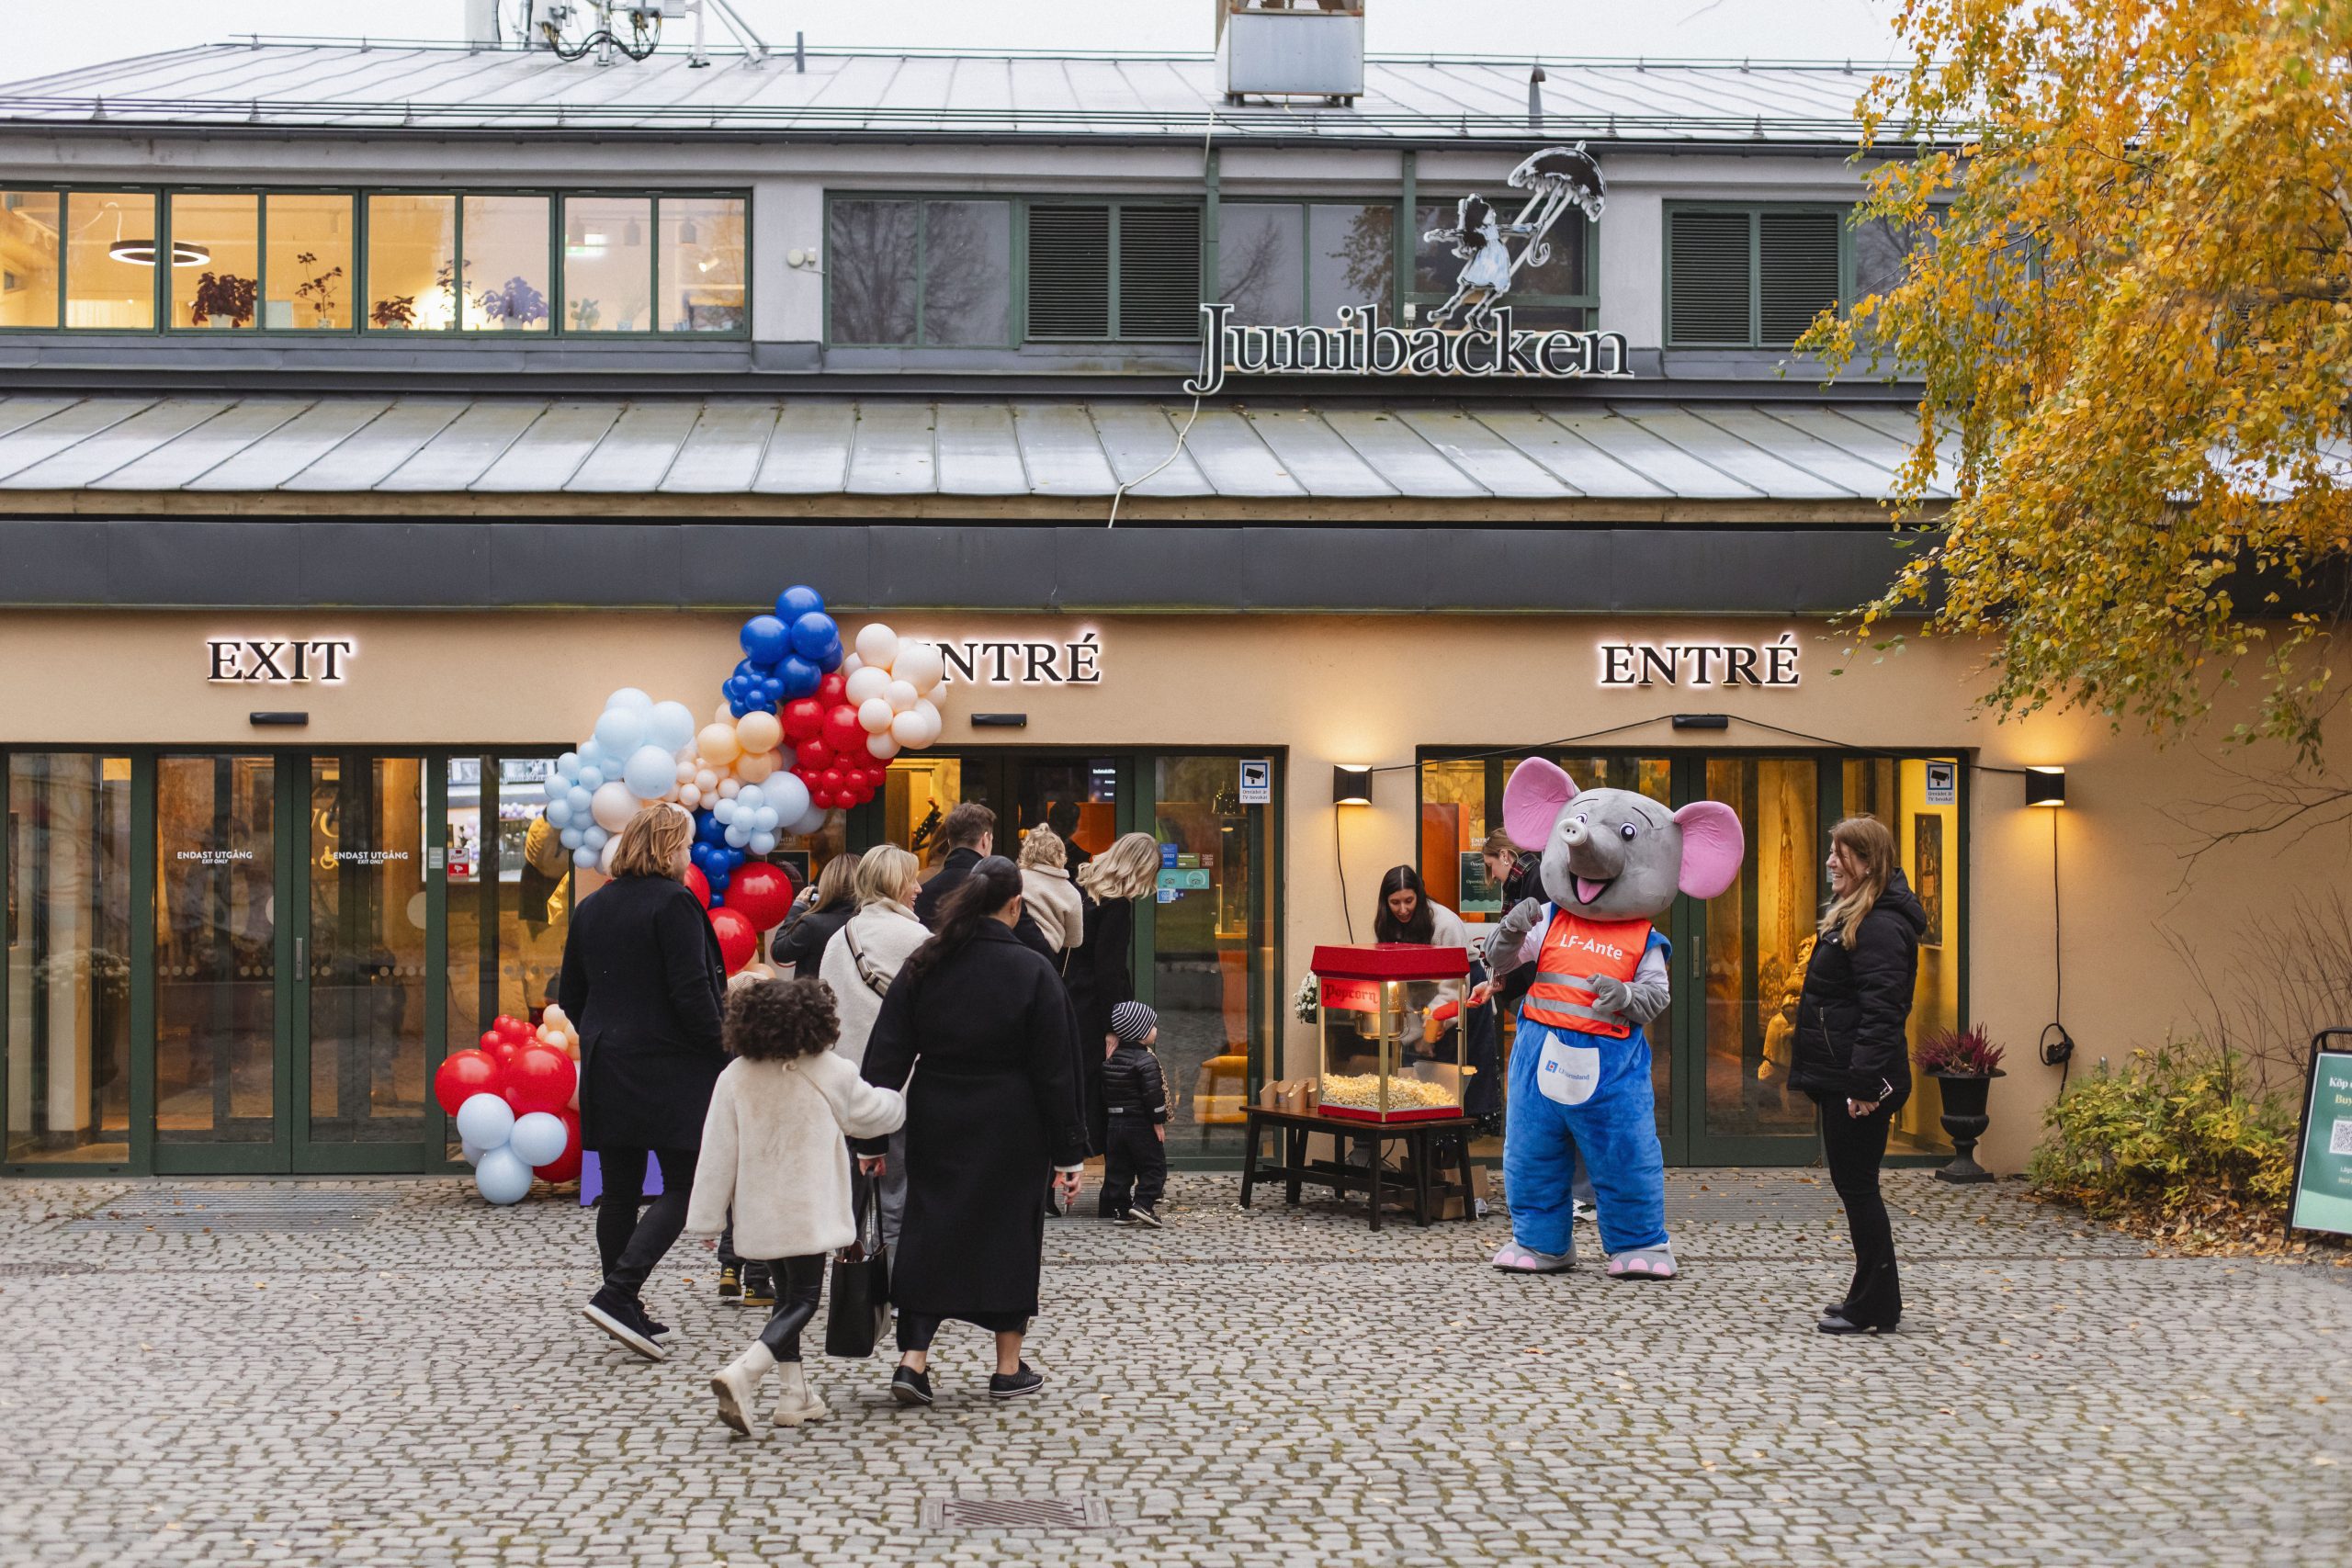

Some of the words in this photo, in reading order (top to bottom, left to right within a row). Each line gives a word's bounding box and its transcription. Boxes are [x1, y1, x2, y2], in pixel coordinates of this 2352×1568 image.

[1183, 303, 1634, 395] Junibacken
[207, 641, 350, 680] EXIT
[919, 633, 1100, 682] NTRÉ
[1600, 634, 1799, 684] ENTRÉ
[177, 852, 212, 860] ENDAST
[215, 849, 253, 860] UTGÅNG
[333, 852, 368, 860] ENDAST
[370, 849, 409, 860] UTGÅNG
[1559, 933, 1623, 961] LF-Ante
[1323, 984, 1378, 1004] Popcorn
[2329, 1077, 2348, 1089] Köp
[2335, 1094, 2352, 1106] Buy
